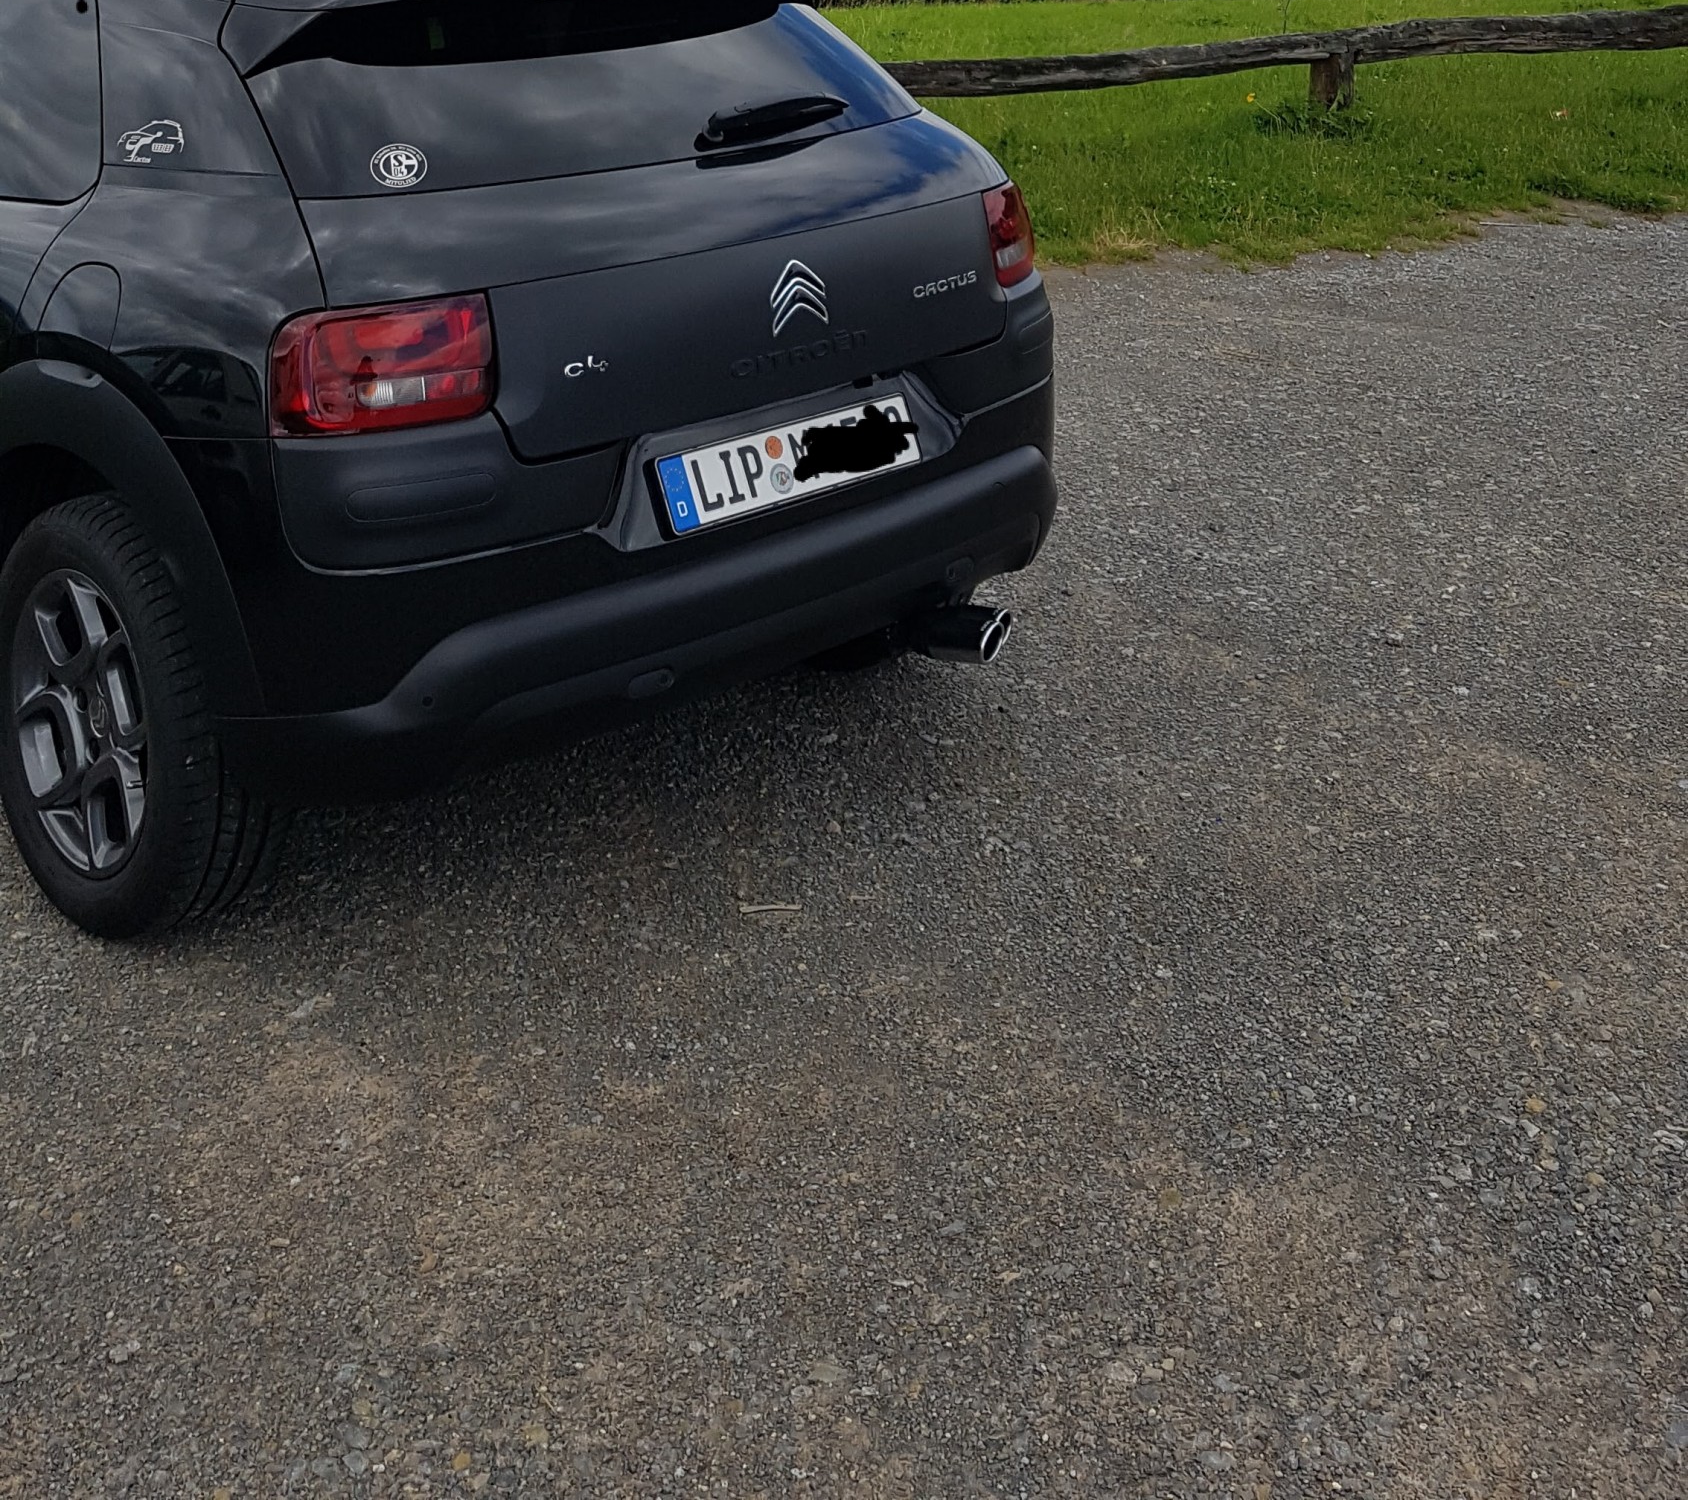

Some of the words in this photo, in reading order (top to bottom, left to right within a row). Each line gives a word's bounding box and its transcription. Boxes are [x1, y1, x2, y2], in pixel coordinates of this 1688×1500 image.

[913, 270, 977, 298] CACTUS
[690, 444, 764, 512] LIP
[676, 500, 689, 518] D
